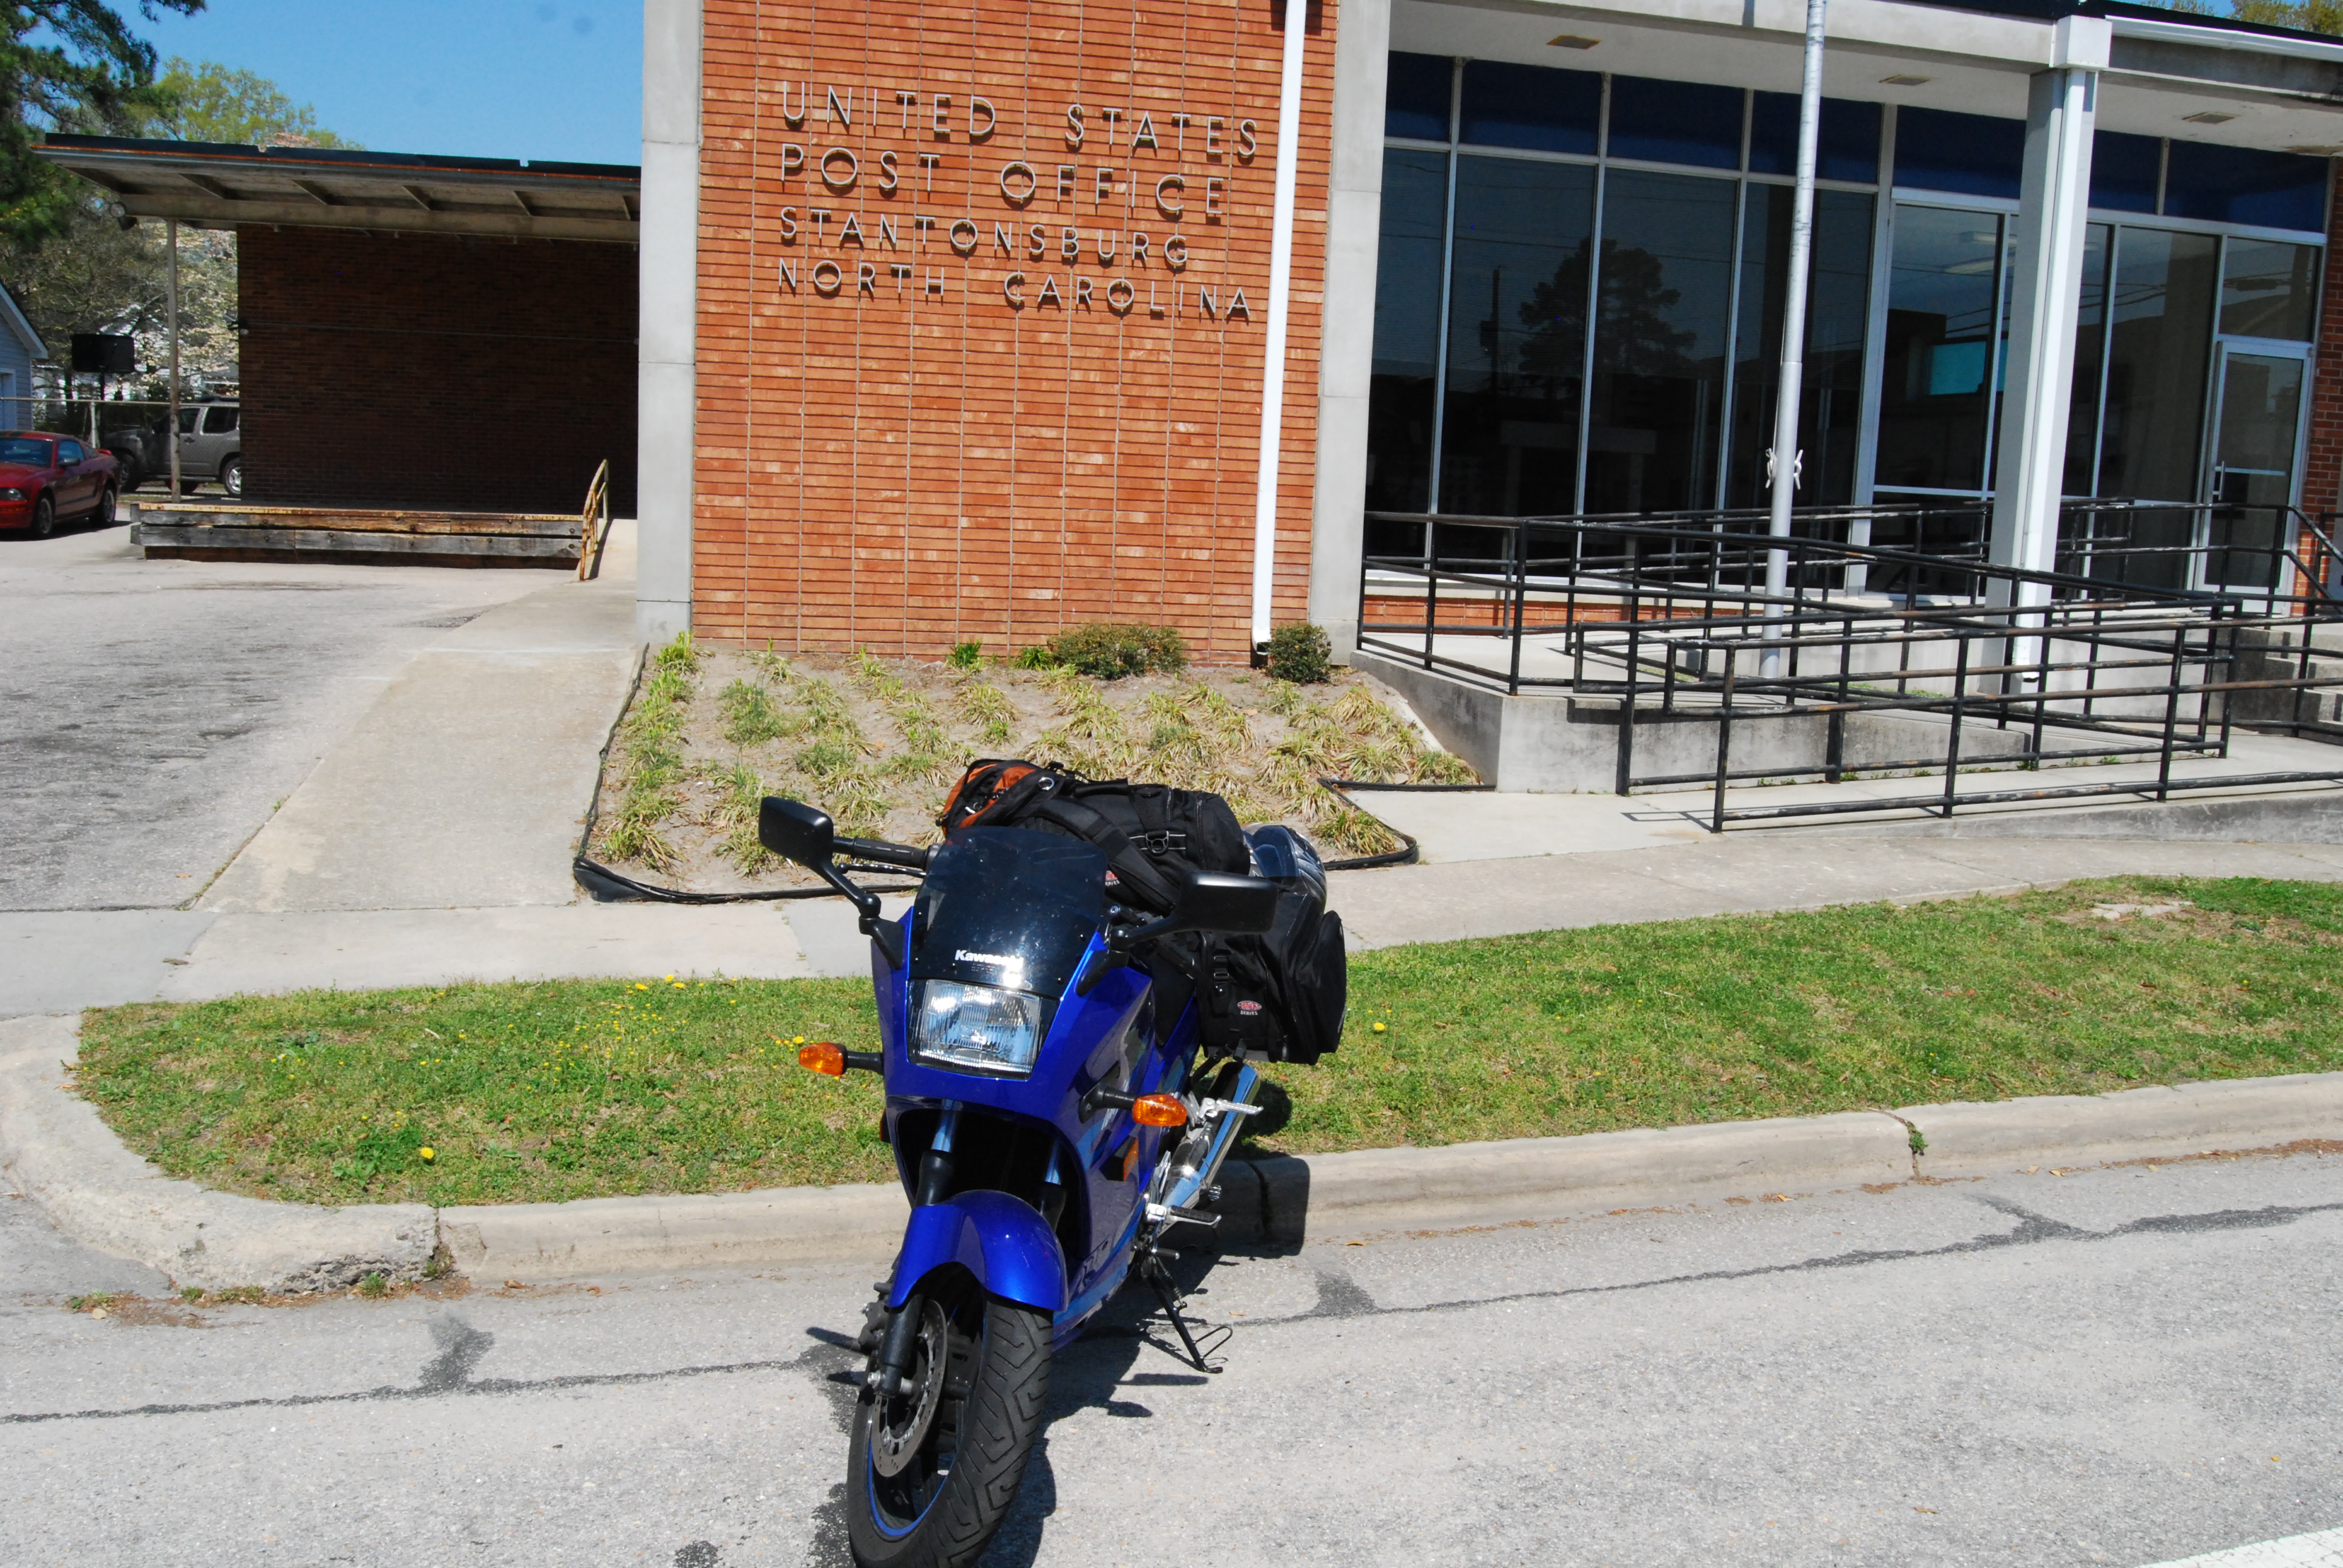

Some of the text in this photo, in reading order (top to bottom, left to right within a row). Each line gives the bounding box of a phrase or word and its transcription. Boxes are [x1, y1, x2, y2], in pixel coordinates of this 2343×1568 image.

[782, 80, 1257, 156] UNITED STATES
[781, 143, 1224, 214] POST OFFICE
[780, 206, 1188, 264] STANTONSBURG
[778, 257, 1251, 316] NORTH CAROLINA
[954, 949, 1024, 969] Kawai
